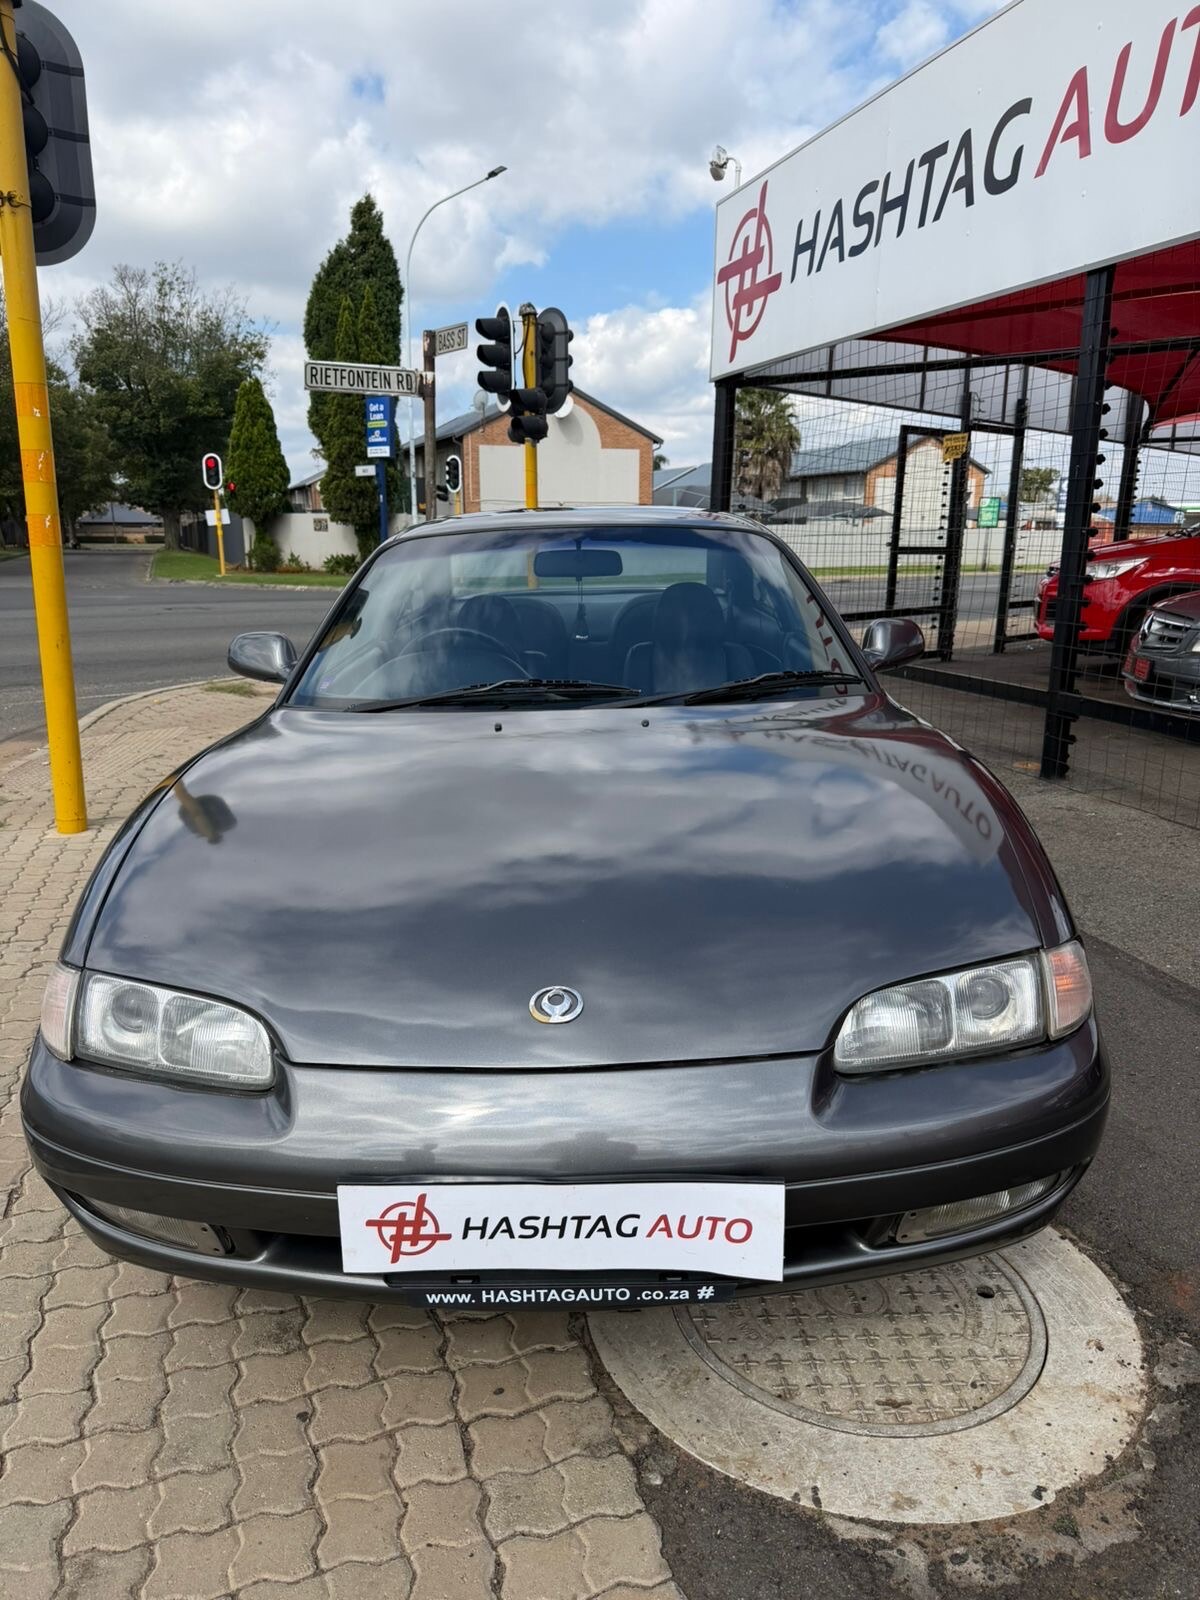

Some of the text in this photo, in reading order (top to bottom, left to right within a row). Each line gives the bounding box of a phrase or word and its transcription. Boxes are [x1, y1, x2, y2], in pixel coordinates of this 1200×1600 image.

[790, 97, 1033, 284] HASHTAG
[438, 328, 466, 351] BASS ST
[310, 366, 413, 391] RIETFONTEIN RD
[369, 403, 379, 412] Get
[369, 412, 384, 420] Loan
[462, 1213, 754, 1244] HASHTAG AUTO
[425, 1293, 476, 1304] www.
[481, 1288, 630, 1303] HASHTAGAUTO
[636, 1289, 690, 1301] .co.za
